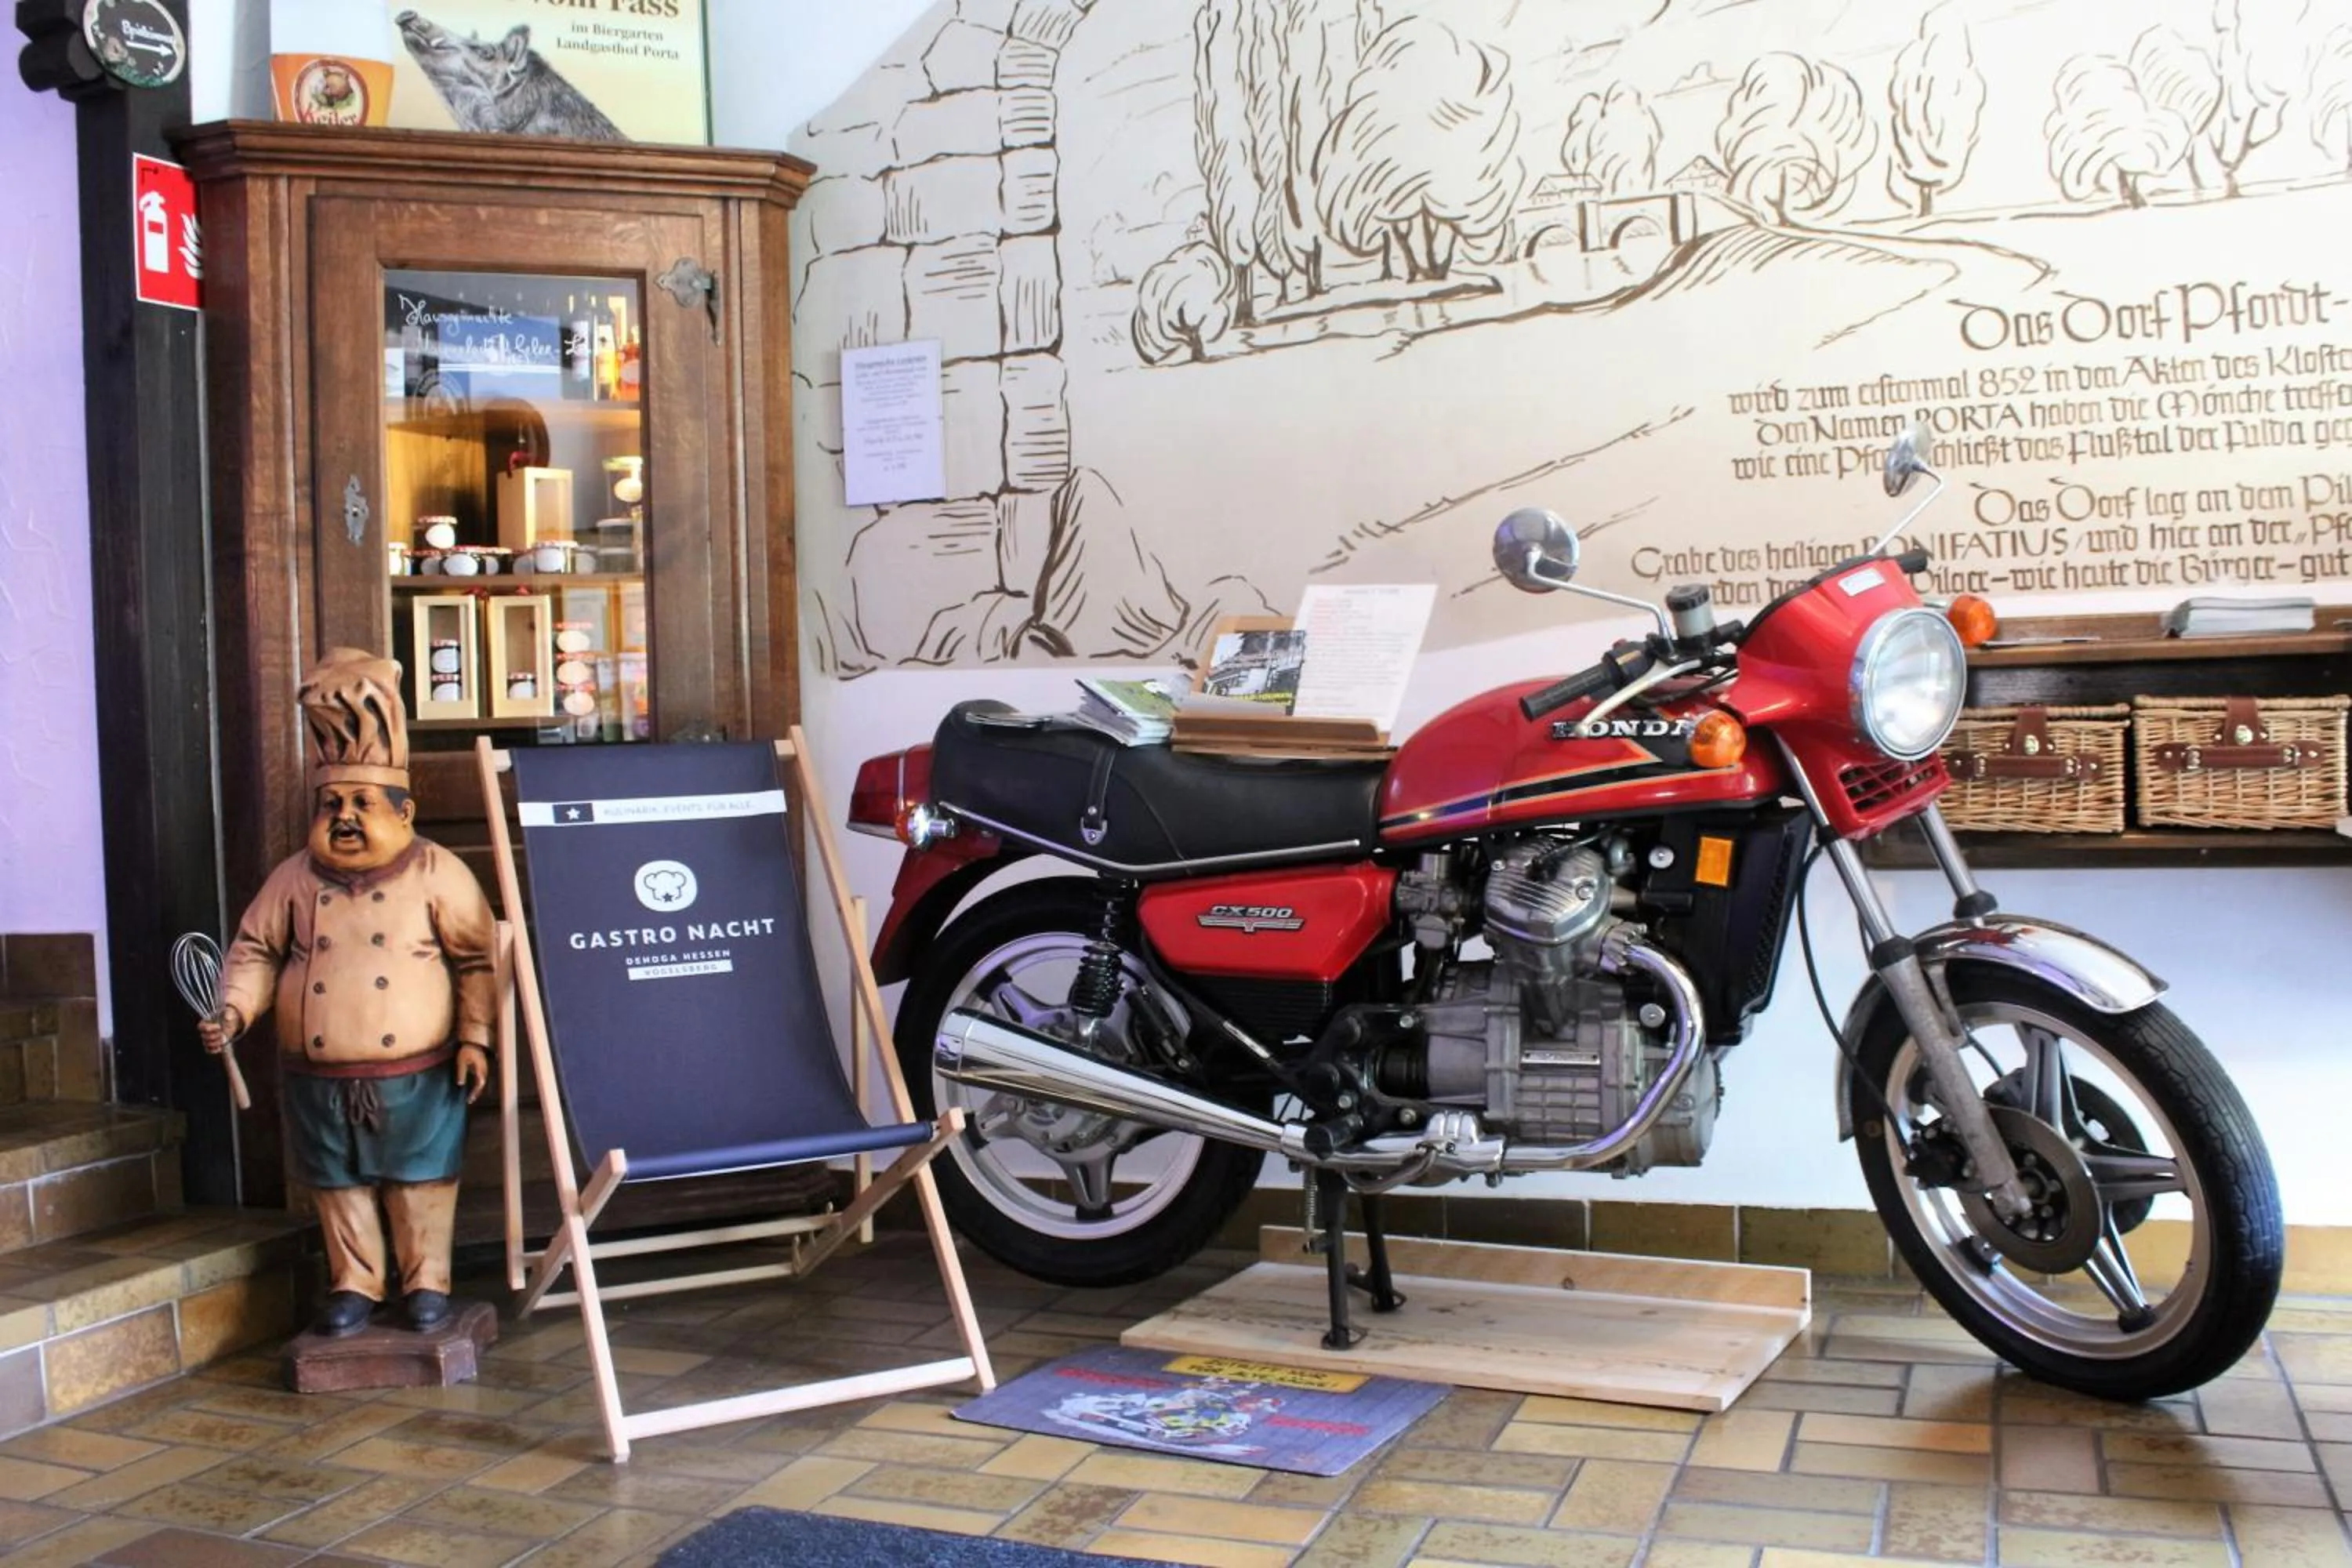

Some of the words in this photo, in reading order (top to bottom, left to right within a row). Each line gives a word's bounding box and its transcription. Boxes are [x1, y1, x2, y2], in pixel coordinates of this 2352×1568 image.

[557, 37, 638, 55] Landgasthof
[644, 47, 679, 60] Porta
[572, 21, 588, 33] im
[593, 23, 663, 42] Biergarten
[1947, 298, 2054, 350] Das
[2051, 289, 2172, 343] Dorf
[1728, 379, 1788, 415] wird
[1796, 385, 1851, 411] zum
[1978, 365, 2041, 397] 852
[2044, 363, 2071, 392] in
[2074, 364, 2118, 390] den
[2122, 355, 2208, 387] Akten
[2212, 352, 2259, 380] des
[1809, 412, 1906, 443] Namen
[1915, 402, 2024, 434] PORTA
[2030, 398, 2103, 430] haben
[2108, 392, 2150, 423] die
[1732, 448, 1778, 481] wie
[1784, 447, 1831, 477] eine
[1931, 434, 2011, 469] chließt
[2017, 436, 2064, 462] das
[2177, 426, 2219, 453] der
[2223, 417, 2307, 453] Fulda
[1969, 481, 2050, 527] Das
[2047, 476, 2140, 521] Dorf
[2145, 486, 2187, 521] lag
[2198, 488, 2232, 513] an
[1631, 546, 1717, 583] Grabe
[1719, 546, 1761, 572] des
[2086, 524, 2139, 553] und
[2149, 521, 2200, 551] hier
[2208, 522, 2243, 546] an
[2249, 517, 2292, 545] der
[2009, 561, 2057, 590] wie
[2063, 560, 2130, 589] heute
[2133, 555, 2172, 586] die
[570, 926, 677, 950] GASTRO
[688, 918, 775, 941] NACHT
[626, 954, 677, 965] DEHOGA
[683, 949, 731, 961] HESSEN
[644, 964, 717, 976] VOGELSBERG
